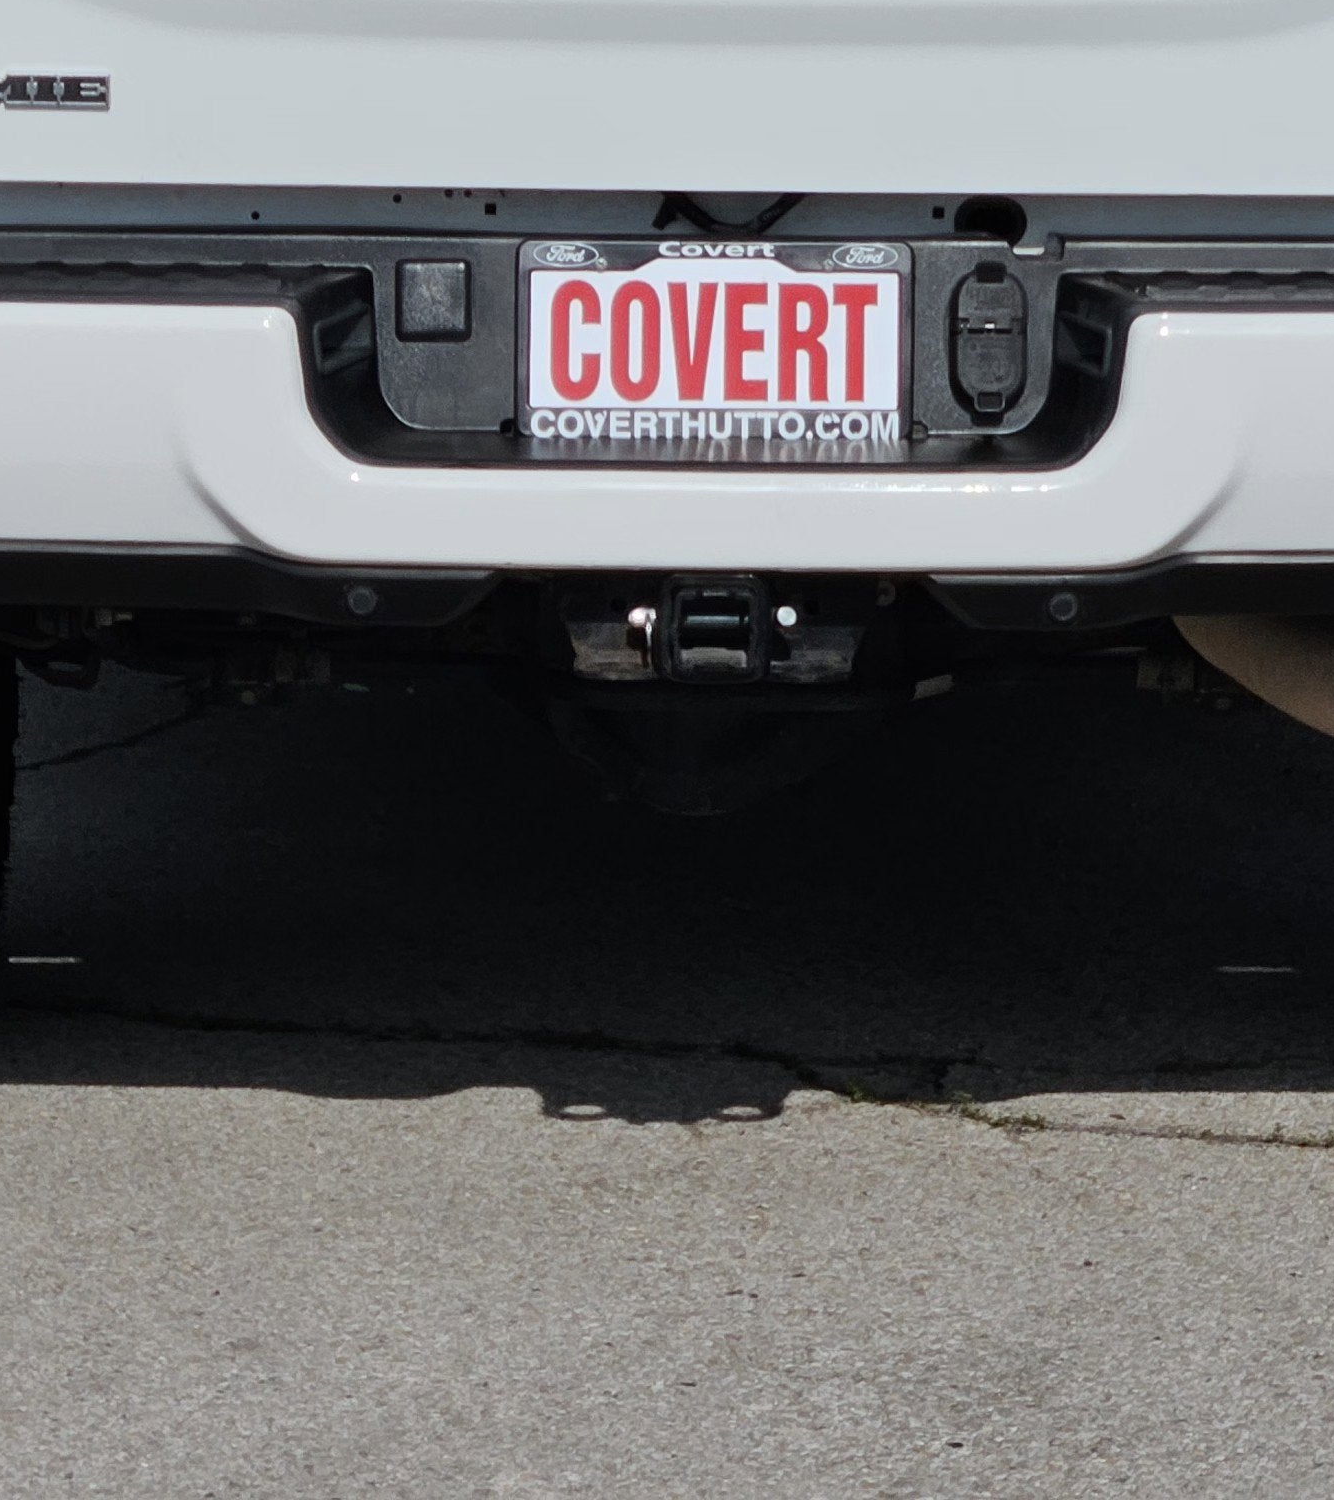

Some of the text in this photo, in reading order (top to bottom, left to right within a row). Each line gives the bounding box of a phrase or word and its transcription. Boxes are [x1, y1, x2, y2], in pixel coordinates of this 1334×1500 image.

[658, 241, 775, 258] Covert
[549, 279, 879, 402] COVERT
[530, 410, 899, 442] COVERTHUTTO.COM
